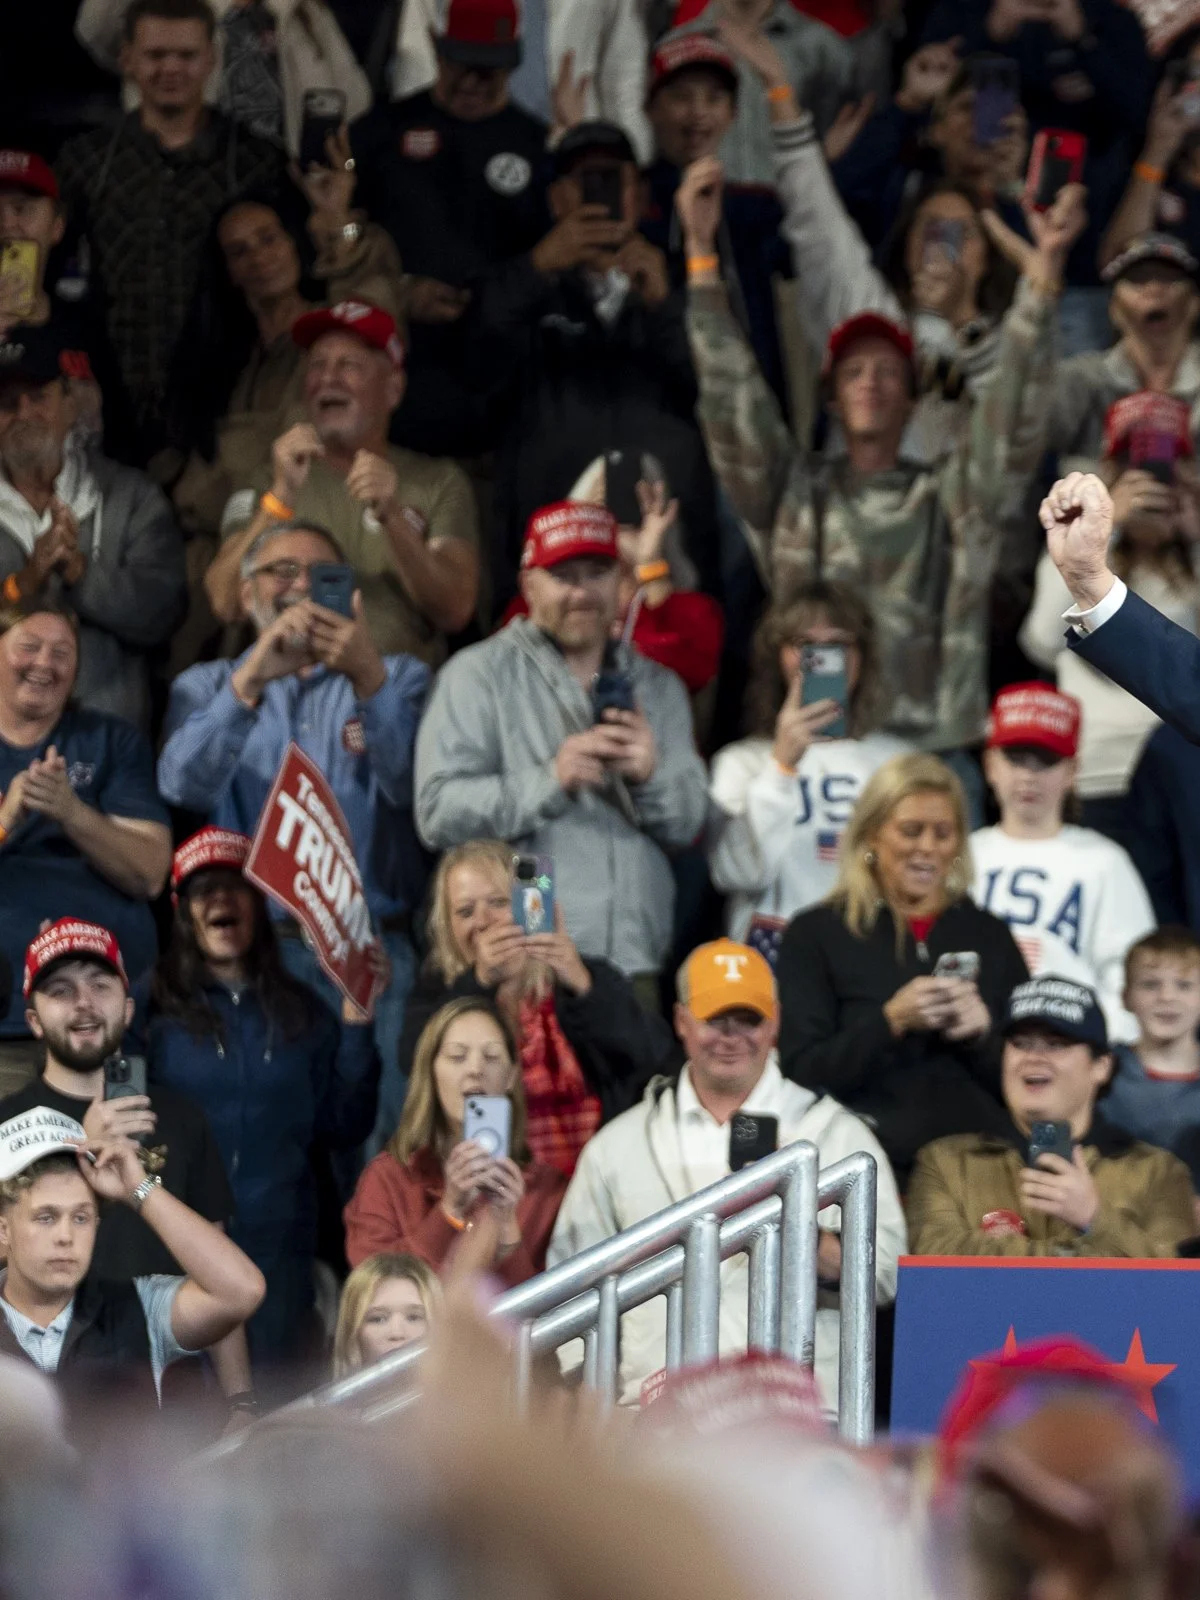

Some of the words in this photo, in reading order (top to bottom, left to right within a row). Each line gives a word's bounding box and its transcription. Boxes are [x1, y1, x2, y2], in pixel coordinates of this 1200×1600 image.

[30, 926, 59, 954] MAKE
[60, 922, 112, 943] AMERICA
[37, 938, 71, 968] GREAT
[72, 936, 107, 957] AGAIN
[713, 954, 748, 982] T
[0, 1118, 32, 1140] MAKE
[9, 1131, 46, 1153] GREAT
